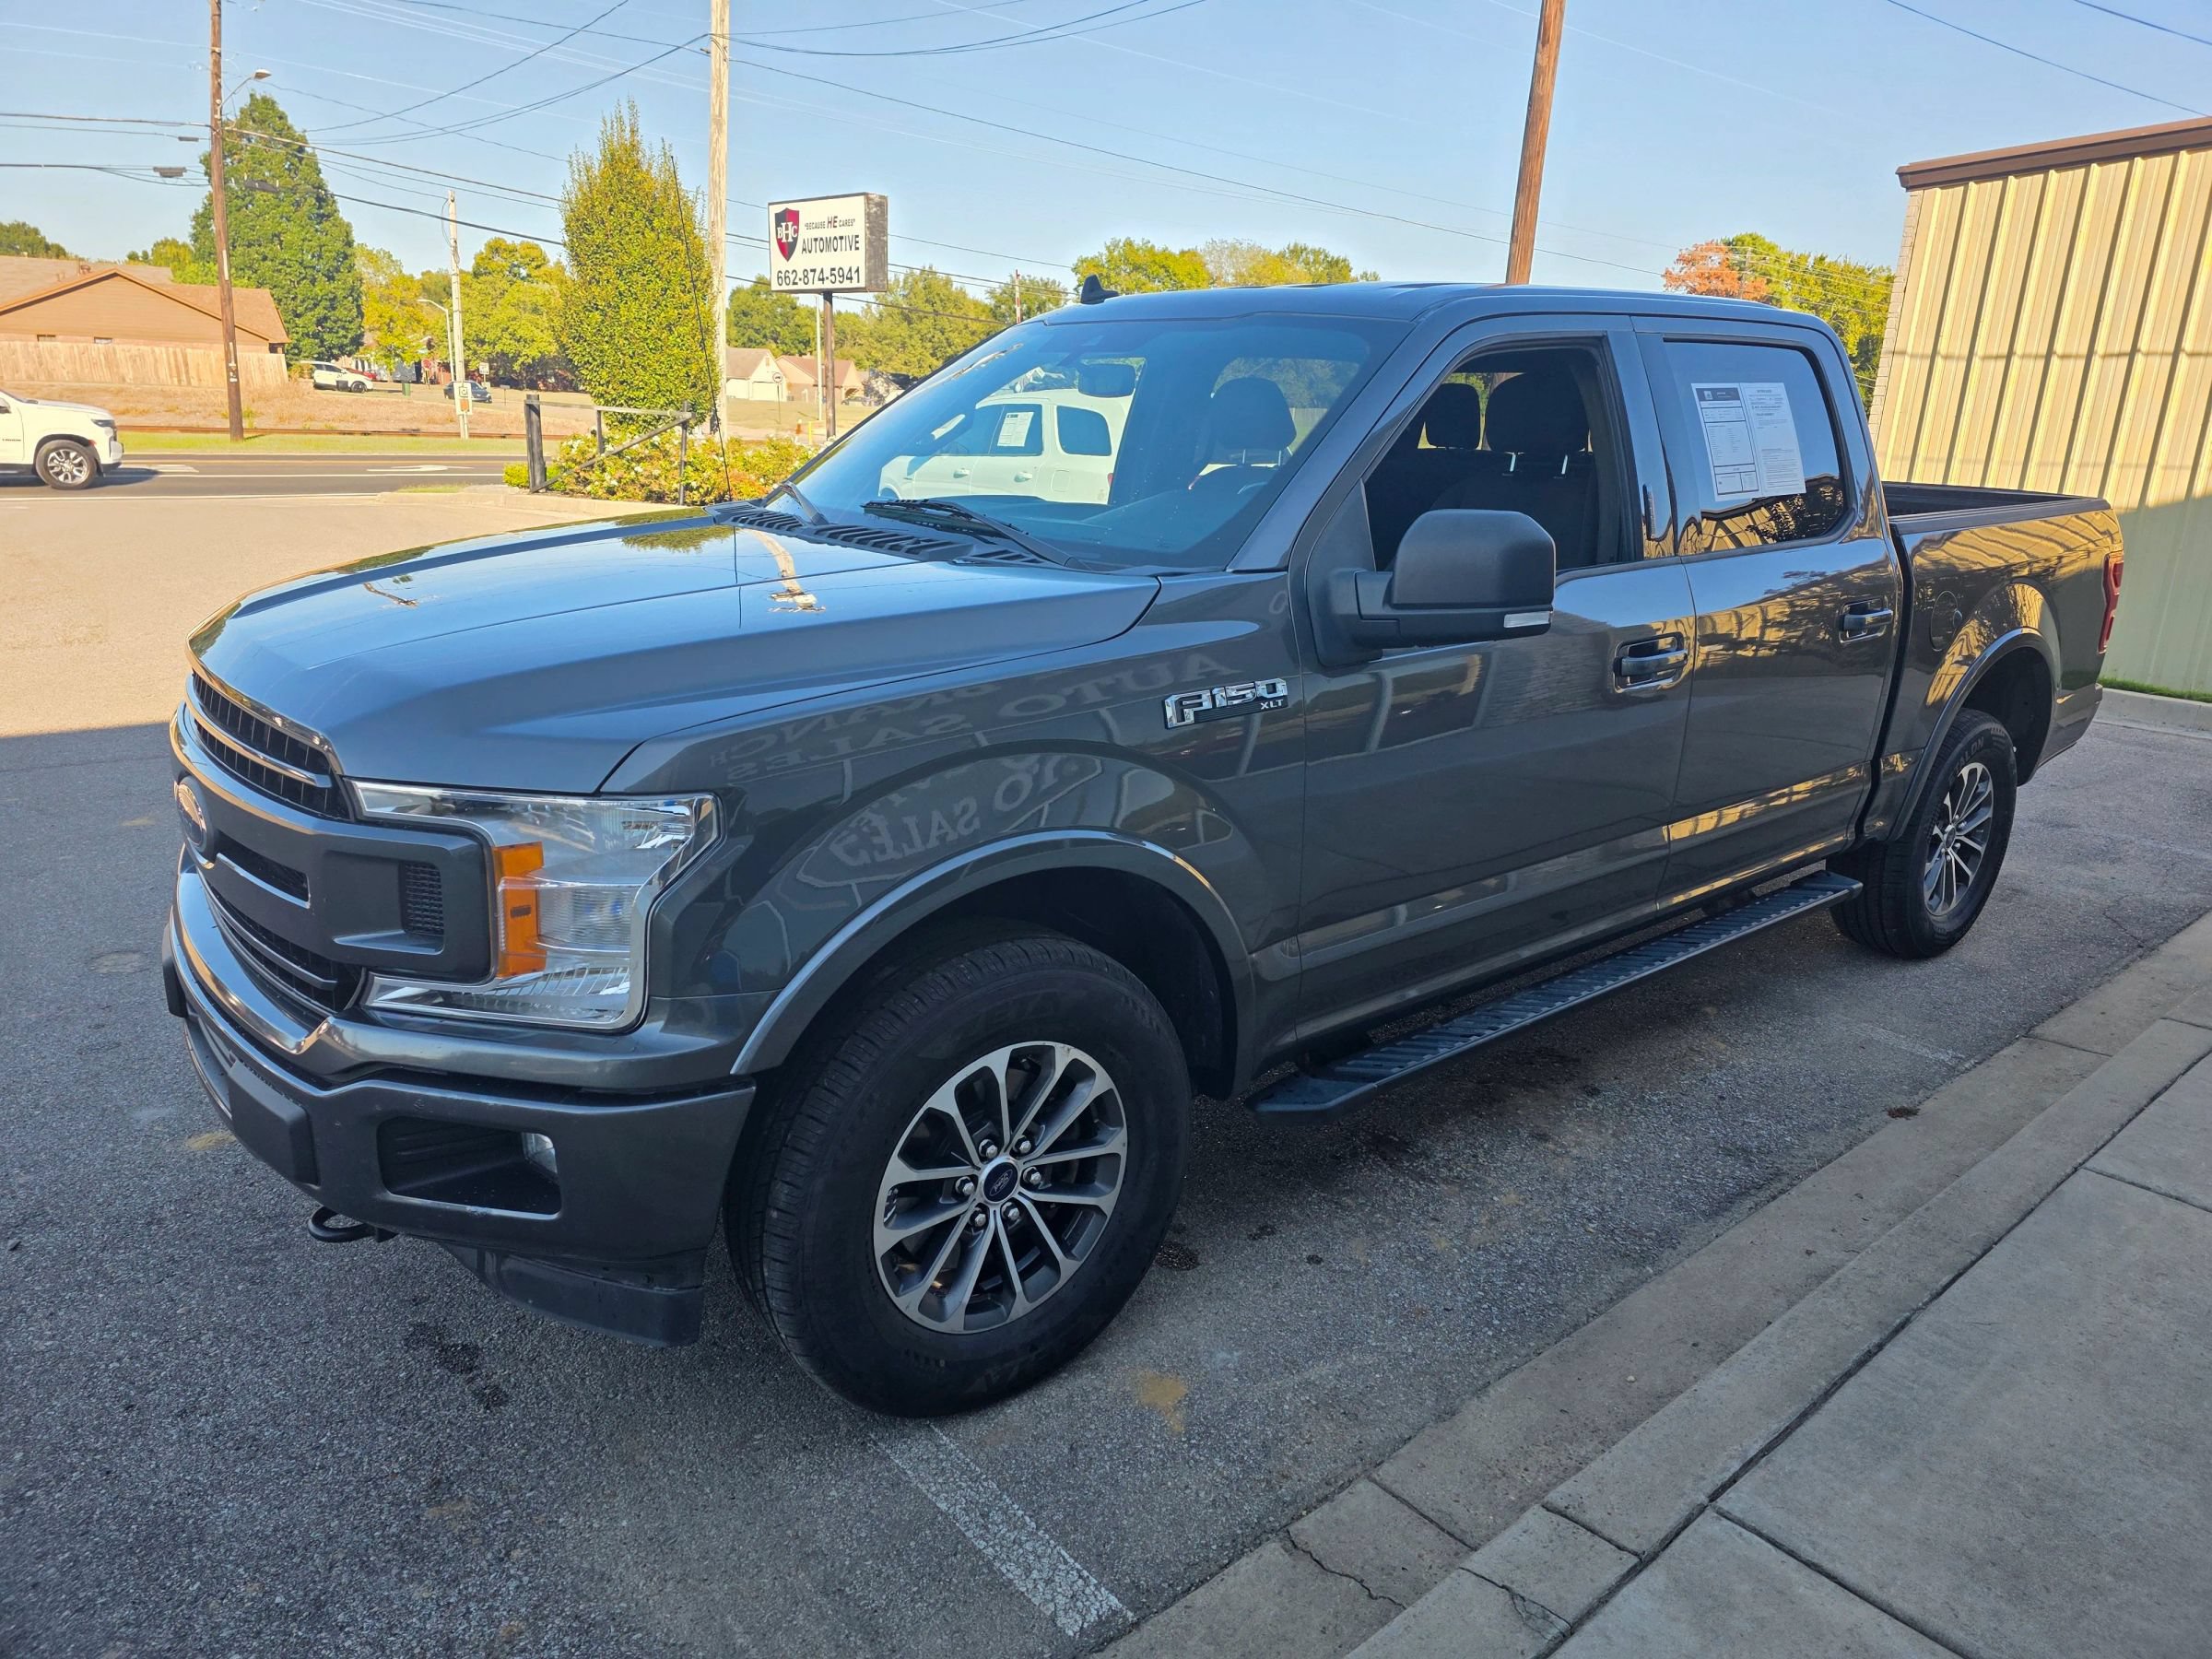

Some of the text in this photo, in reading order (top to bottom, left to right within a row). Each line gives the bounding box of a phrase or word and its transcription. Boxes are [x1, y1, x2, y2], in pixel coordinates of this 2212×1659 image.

[827, 216, 838, 229] HE
[801, 234, 860, 254] AUTOMOTIVE
[776, 265, 861, 287] 662-874-5941
[1260, 699, 1284, 710] XLT
